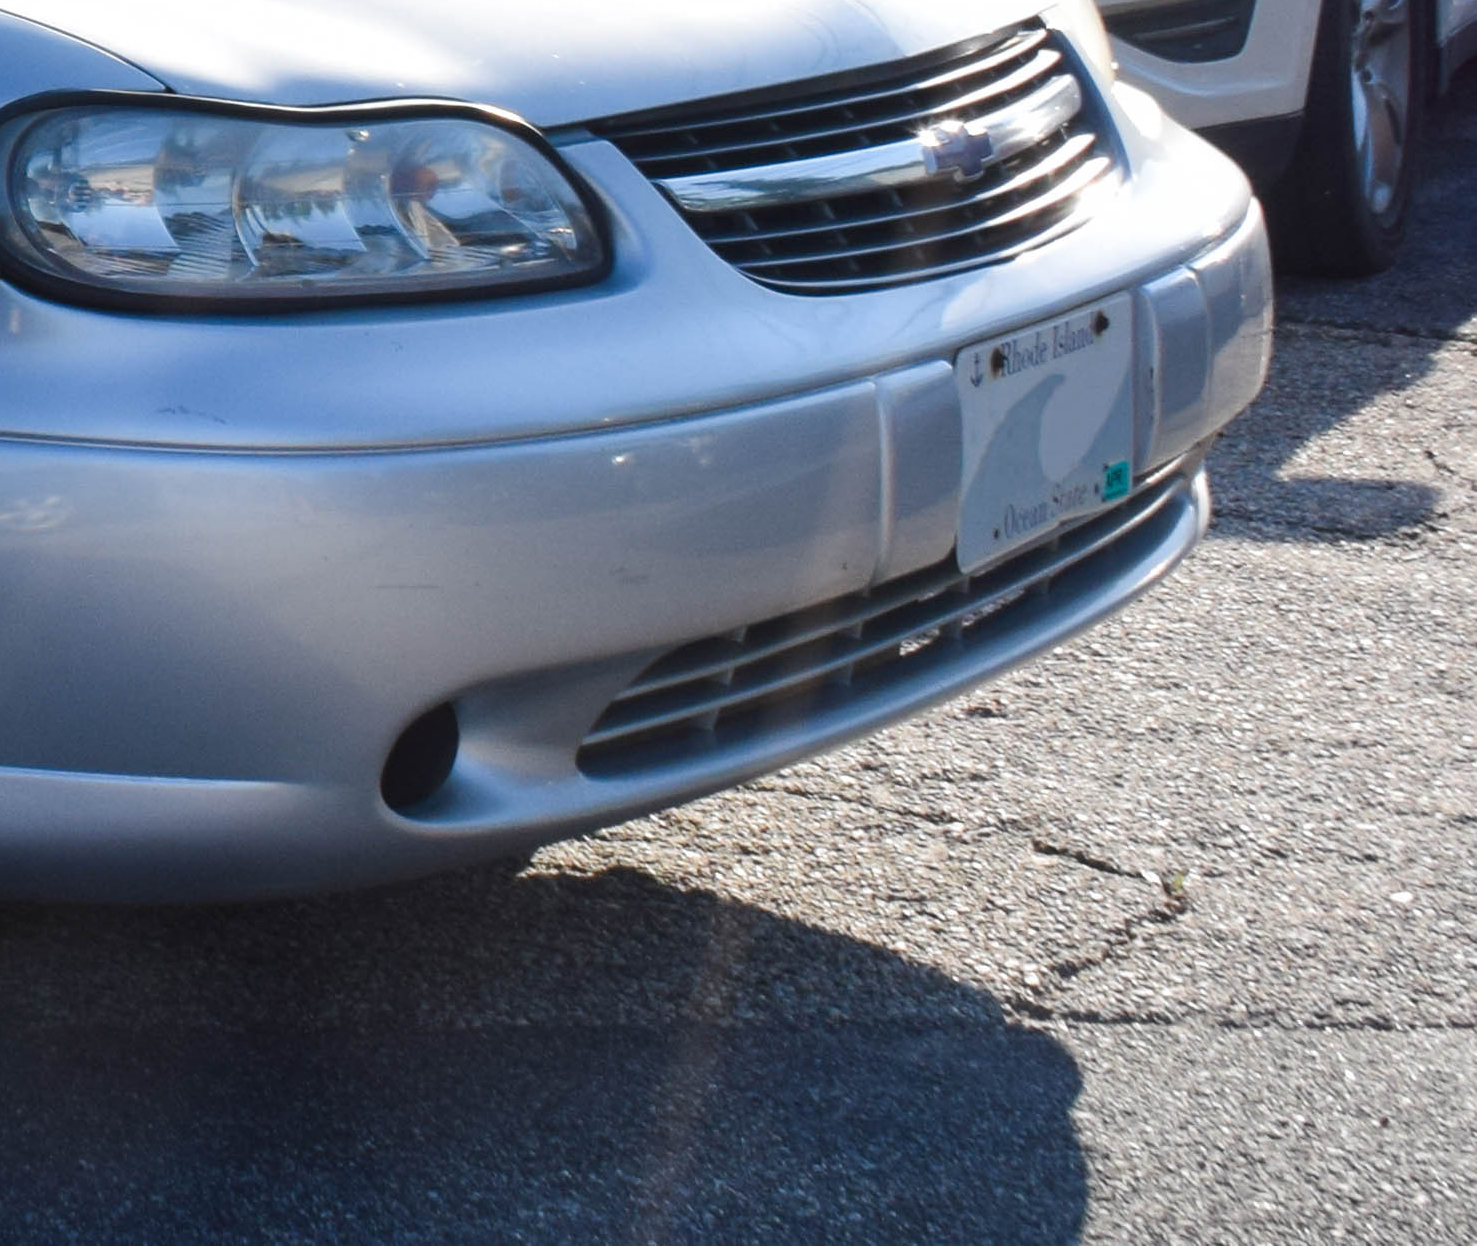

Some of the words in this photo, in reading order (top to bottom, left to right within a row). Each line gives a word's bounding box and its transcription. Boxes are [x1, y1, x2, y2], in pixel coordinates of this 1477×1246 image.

[1000, 331, 1048, 378] Rhode
[1051, 311, 1095, 359] Island
[1004, 504, 1048, 538] Ocean
